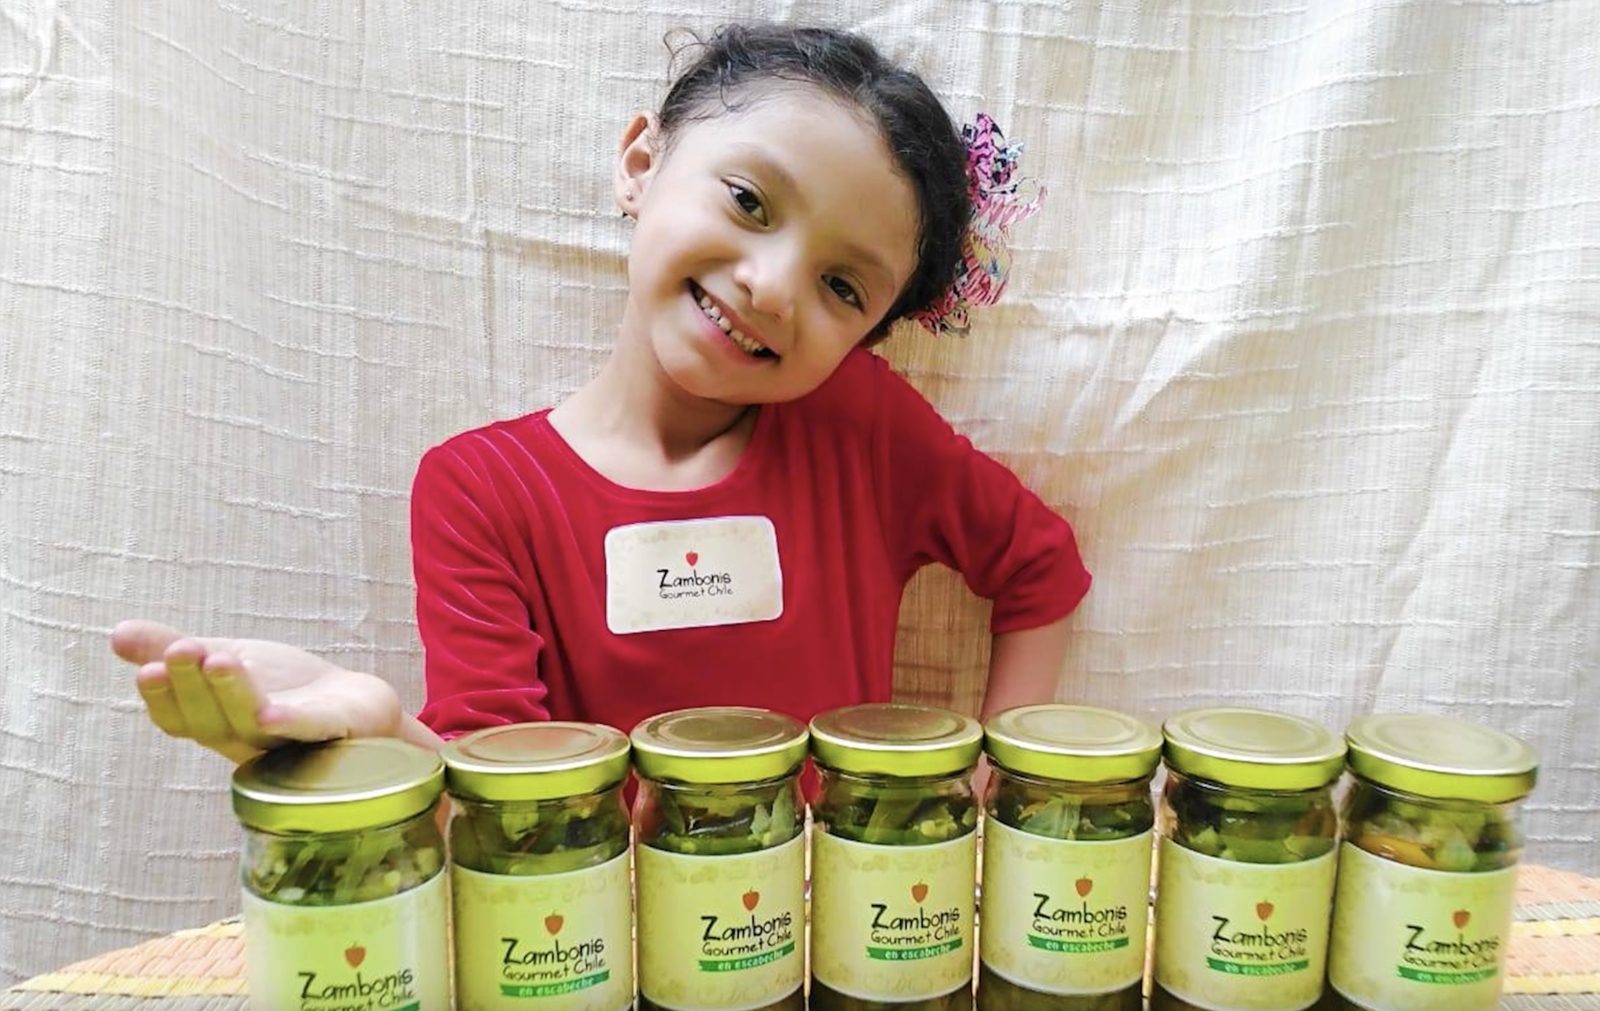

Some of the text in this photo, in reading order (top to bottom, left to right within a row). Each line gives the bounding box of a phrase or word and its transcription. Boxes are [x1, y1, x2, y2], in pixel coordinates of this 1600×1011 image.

[656, 568, 732, 589] Zambonis
[658, 584, 734, 599] Gourmet Chile
[871, 903, 960, 929] Zambonis
[1033, 893, 1127, 924] Zambonis
[701, 911, 792, 941] Zambonis
[871, 924, 960, 946] Gourmet Chile
[1032, 919, 1127, 937] Gourmet Chile
[1211, 915, 1307, 948] Zambonis
[502, 937, 605, 965] Zambonis
[702, 929, 792, 957] Gourmet Chile
[885, 949, 898, 960] en
[503, 956, 605, 982] Gourmet Chile
[718, 961, 732, 971] en
[298, 968, 413, 1000] Zambonis
